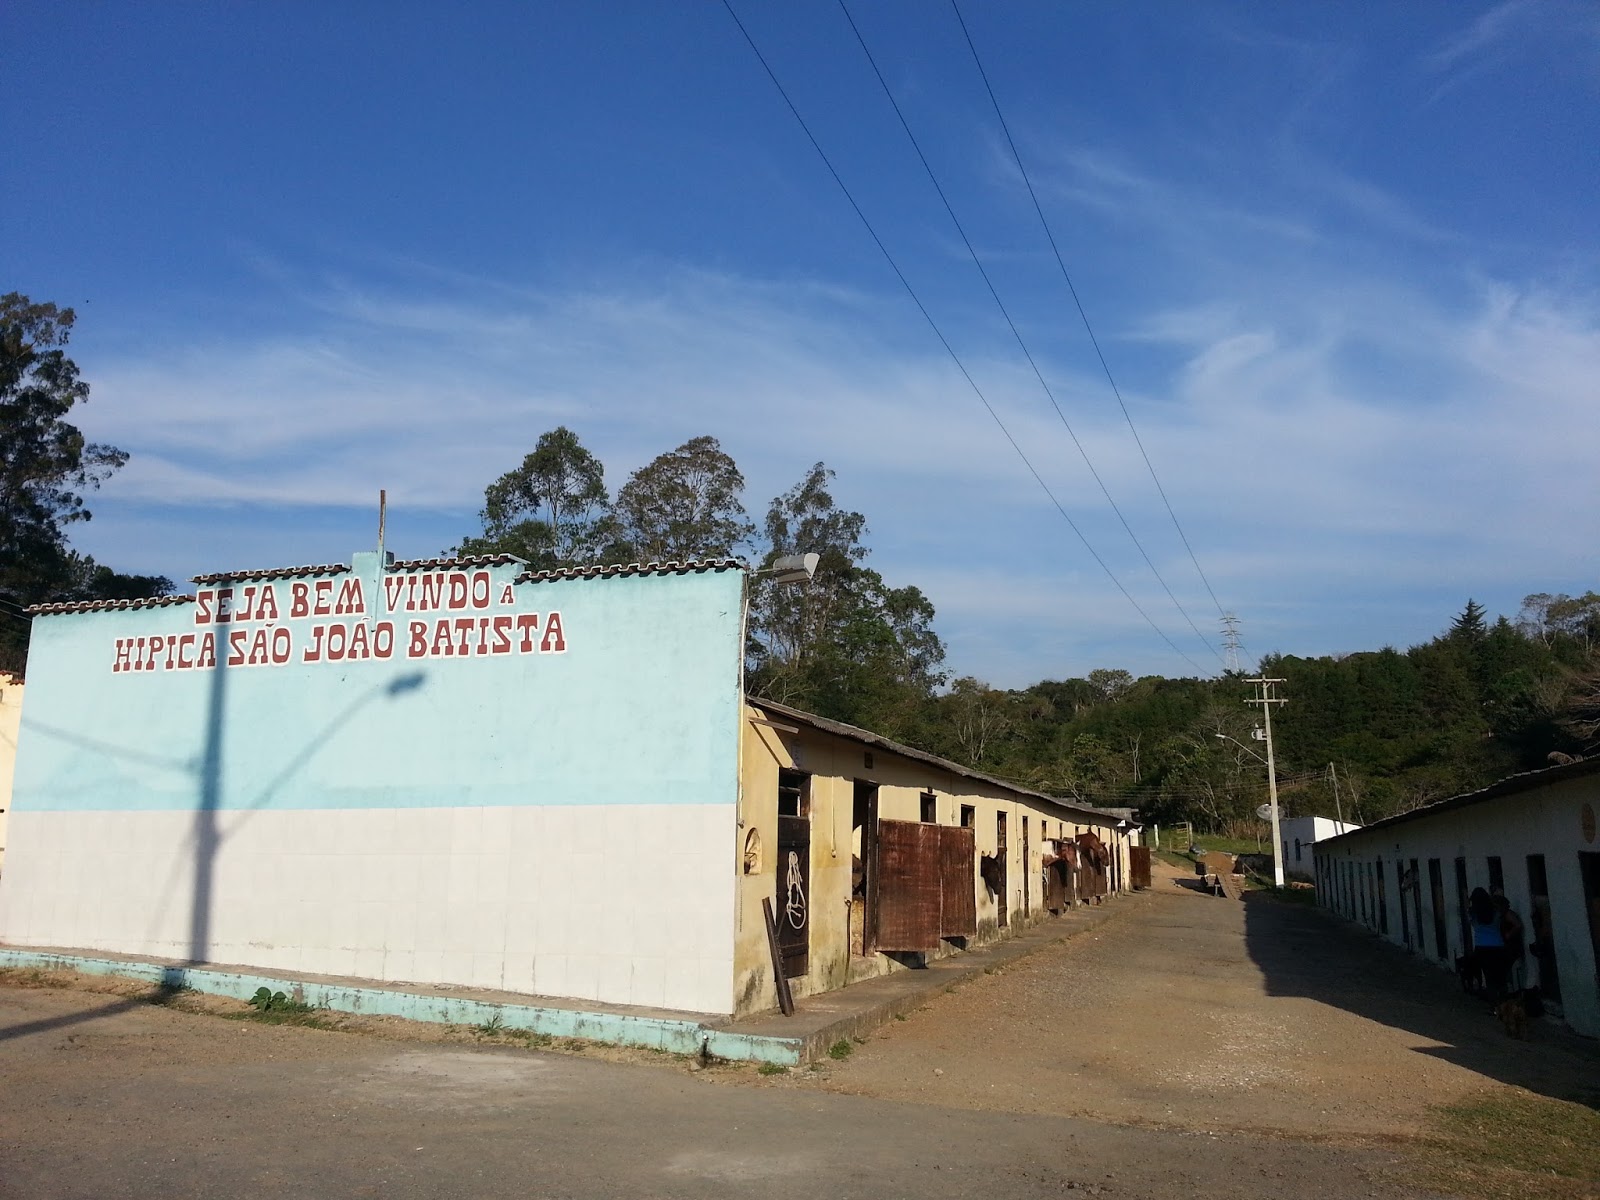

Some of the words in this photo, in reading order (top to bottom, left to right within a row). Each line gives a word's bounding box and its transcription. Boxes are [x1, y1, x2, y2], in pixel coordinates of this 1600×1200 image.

[195, 585, 279, 625] SEJA
[290, 578, 365, 618] BEM
[384, 571, 491, 614] VINDO
[112, 632, 216, 673] HIPICA
[228, 621, 292, 666] SÃO
[303, 616, 395, 662] JOÃO
[408, 612, 566, 658] BATISTA
